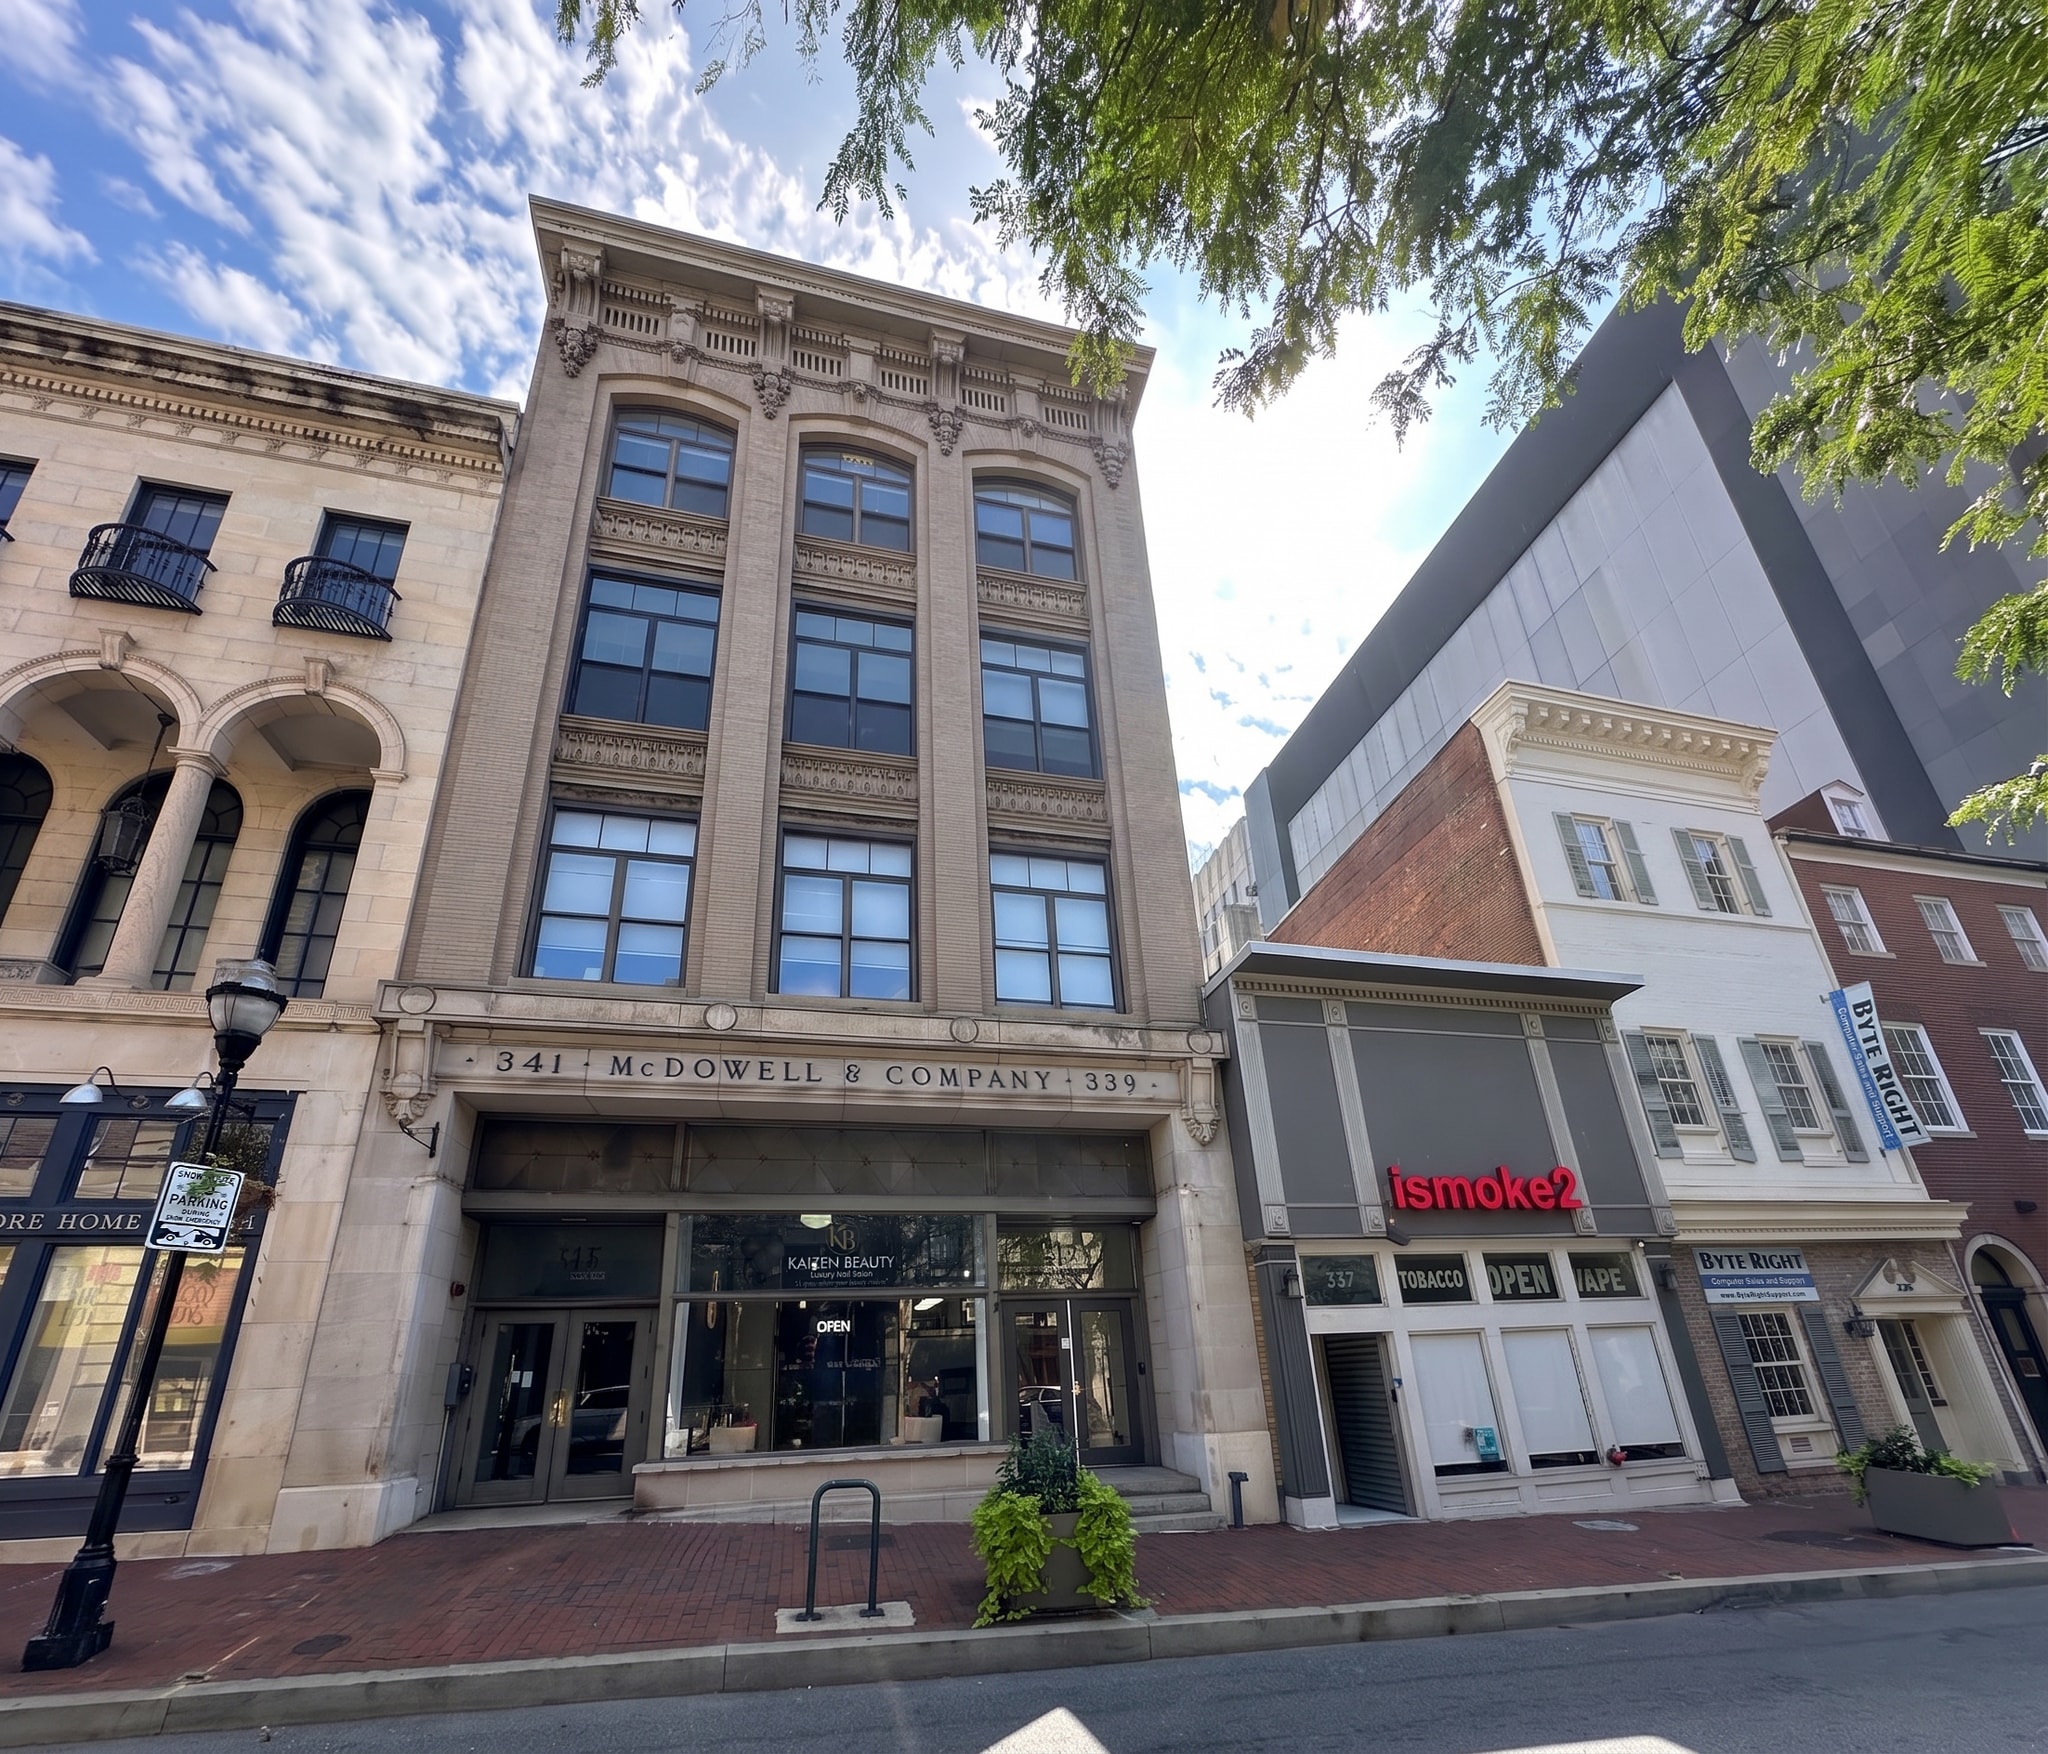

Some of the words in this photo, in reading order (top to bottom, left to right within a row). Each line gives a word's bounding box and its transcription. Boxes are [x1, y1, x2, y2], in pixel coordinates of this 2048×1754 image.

[496, 1051, 561, 1073] 341
[609, 1055, 822, 1082] McDOWELL
[845, 1063, 860, 1083] &
[886, 1065, 1051, 1090] COMPANY
[1085, 1072, 1136, 1096] 339
[1852, 999, 1882, 1059] BYTE
[1872, 1062, 1921, 1136] RIGHT
[1872, 1100, 1895, 1139] Support
[178, 1170, 202, 1180] SNOW
[1387, 1164, 1583, 1210] ismoke2
[169, 1194, 228, 1210] PARKING
[56, 1213, 142, 1230] HOME
[182, 1209, 210, 1217] DURING
[788, 1256, 839, 1270] KAIZEN
[844, 1255, 895, 1268] BEAUTY
[1699, 1252, 1747, 1269] BYTE
[1748, 1252, 1802, 1269] RIGHT
[810, 1271, 835, 1279] Luxury
[836, 1270, 851, 1278] Nail
[853, 1270, 873, 1278] Salon
[1325, 1271, 1354, 1288] 337
[1399, 1268, 1464, 1289] TOBACCO
[1487, 1264, 1552, 1295] OPEN
[1711, 1277, 1744, 1286] Computer
[1766, 1276, 1778, 1284] and
[1779, 1276, 1805, 1285] Support
[817, 1320, 851, 1332] OPEN
